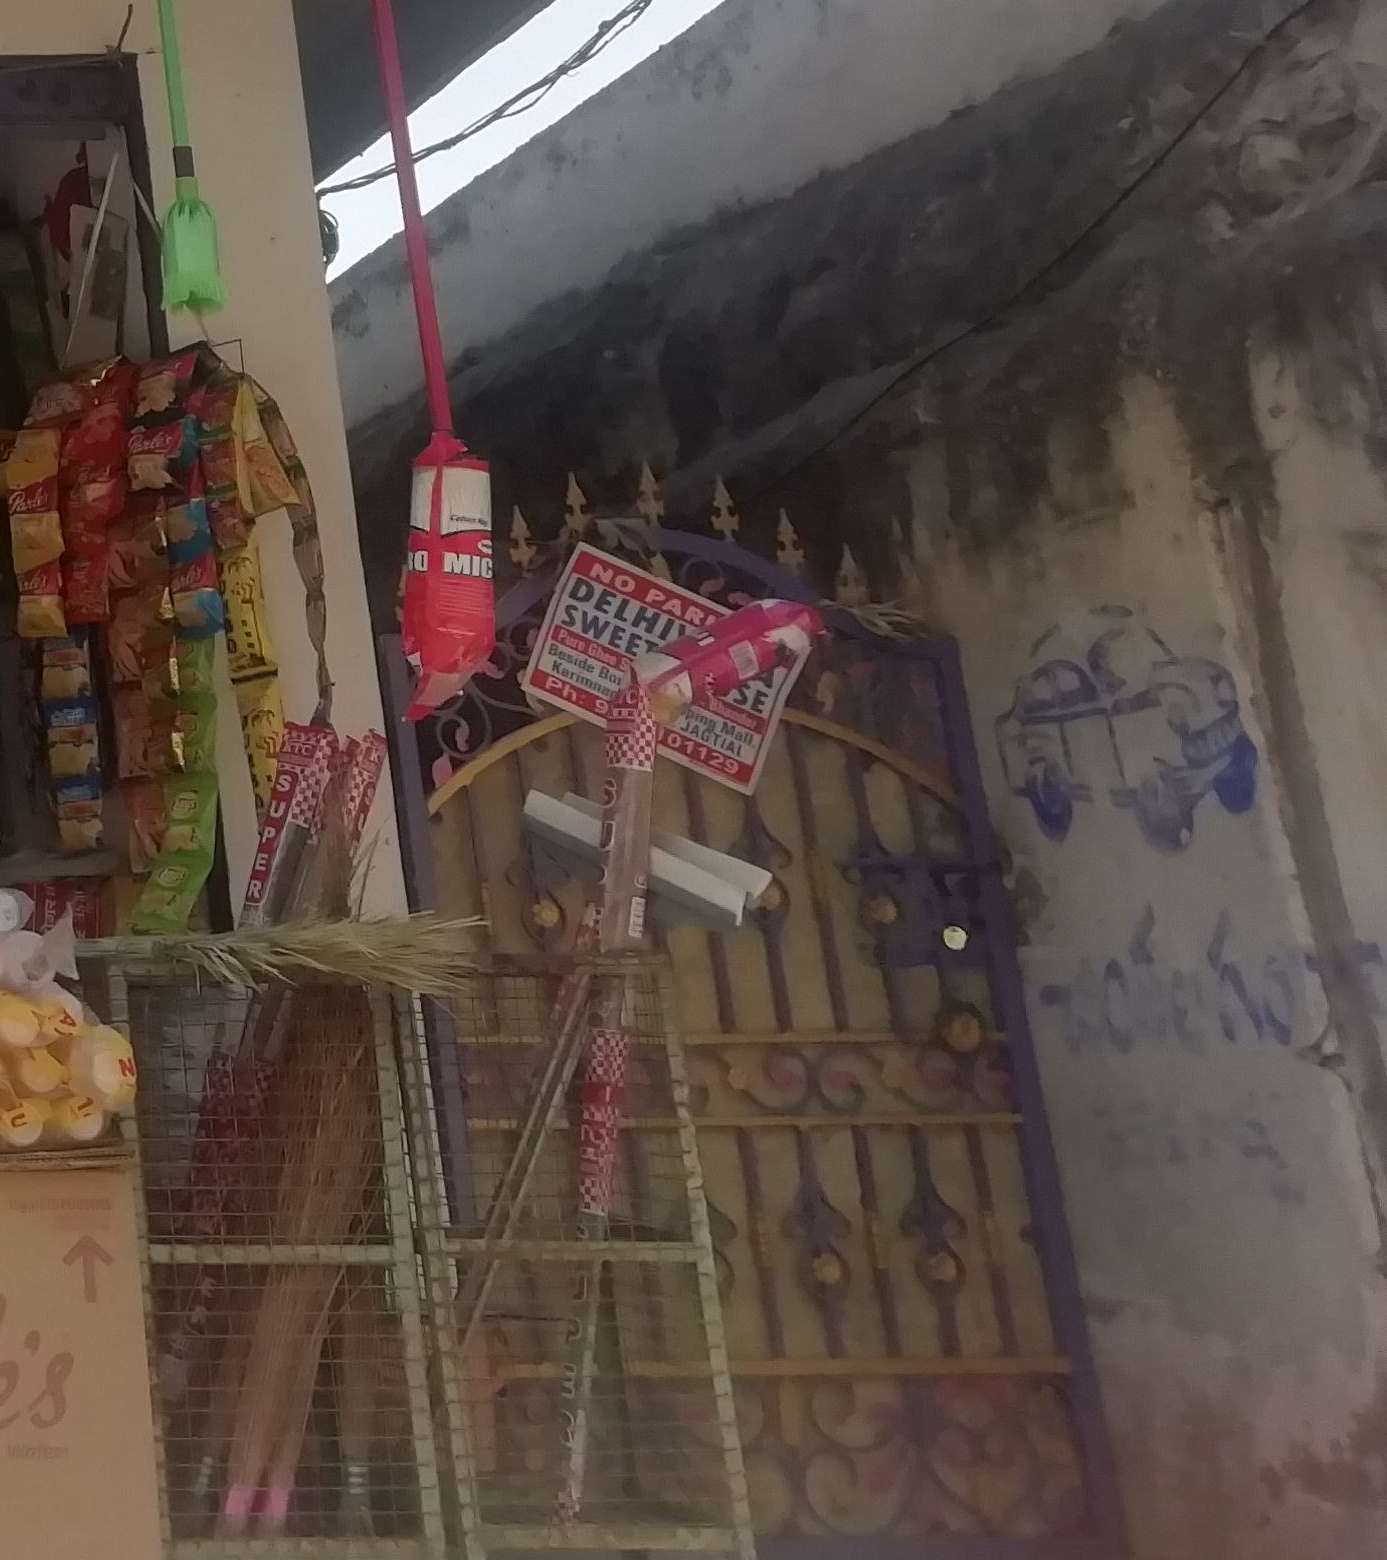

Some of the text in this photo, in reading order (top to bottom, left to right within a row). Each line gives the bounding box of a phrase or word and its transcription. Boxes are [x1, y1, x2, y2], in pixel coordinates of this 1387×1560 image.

[588, 561, 637, 594] NO
[547, 641, 596, 674] Beside
[680, 721, 744, 758] JAGTIAL
[246, 773, 295, 900] SUPER
